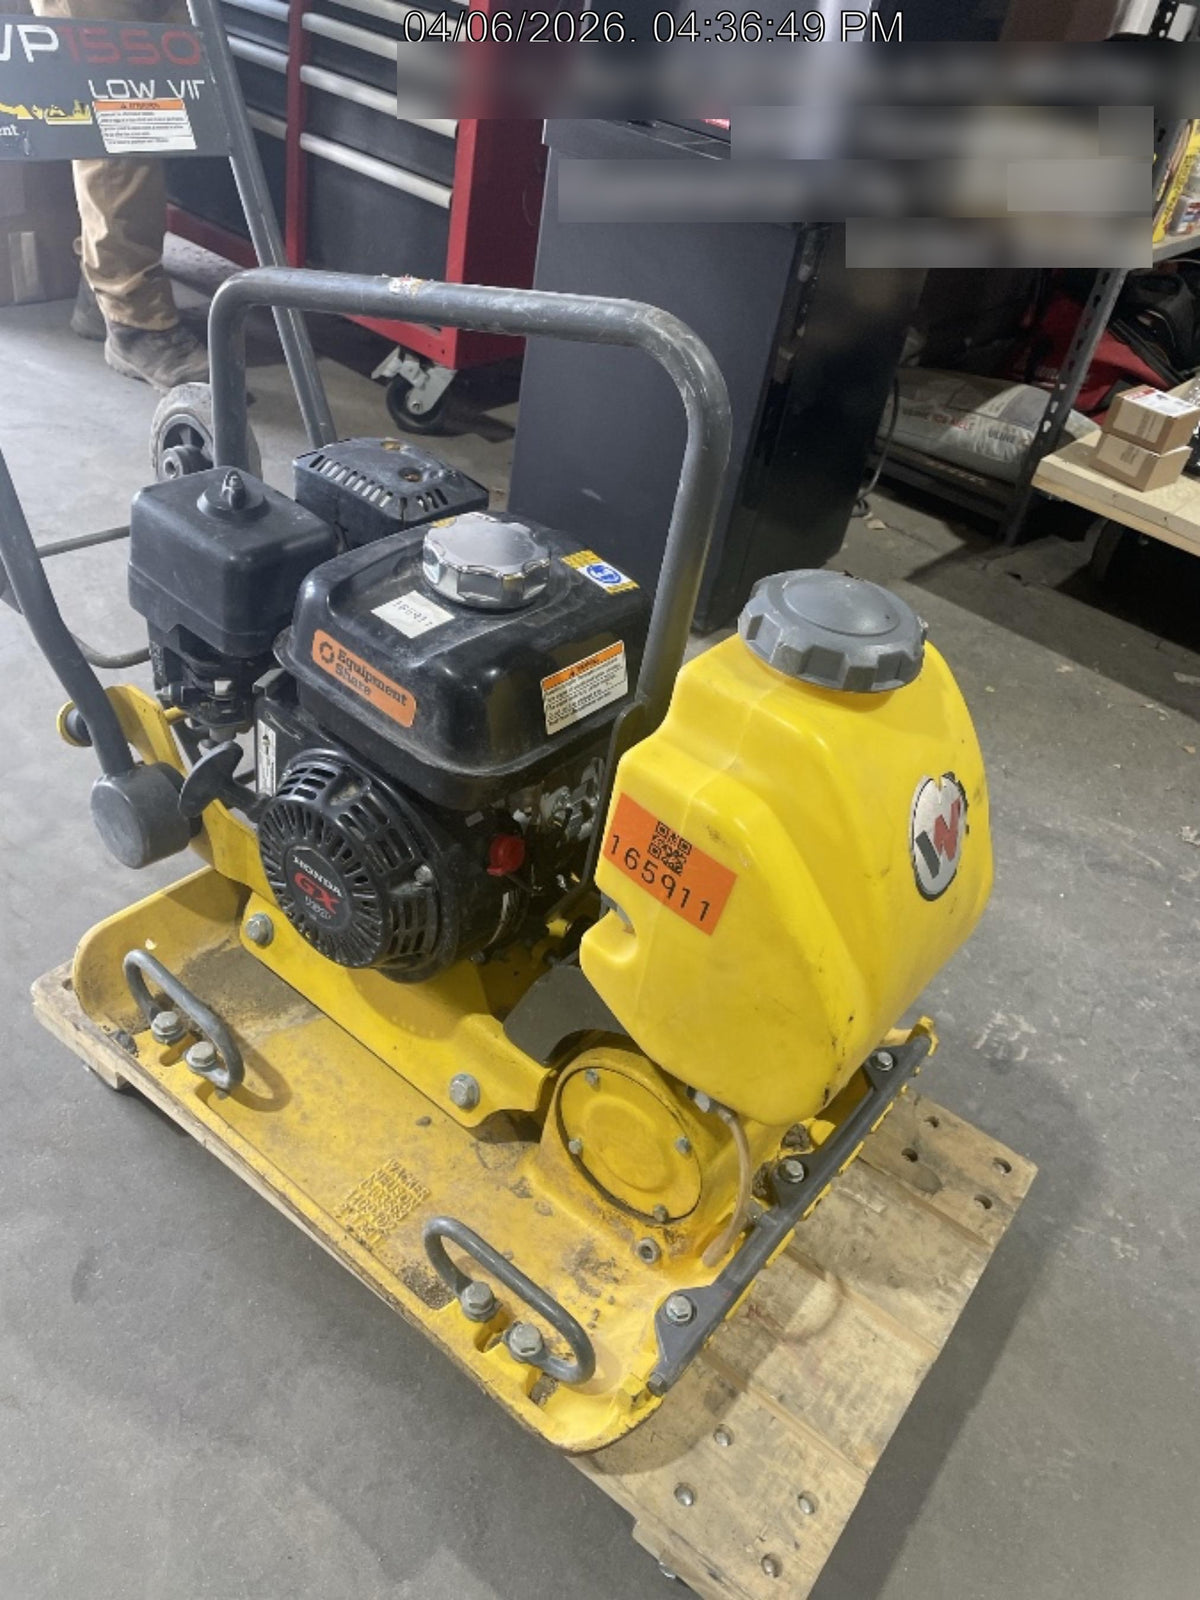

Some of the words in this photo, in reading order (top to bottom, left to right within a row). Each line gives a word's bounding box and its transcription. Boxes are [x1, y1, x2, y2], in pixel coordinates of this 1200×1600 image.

[88, 79, 155, 99] LOW
[335, 662, 371, 696] Share
[338, 649, 407, 706] Equipment
[292, 854, 344, 897] HONDA
[294, 871, 340, 914] GX
[611, 834, 710, 922] 165911
